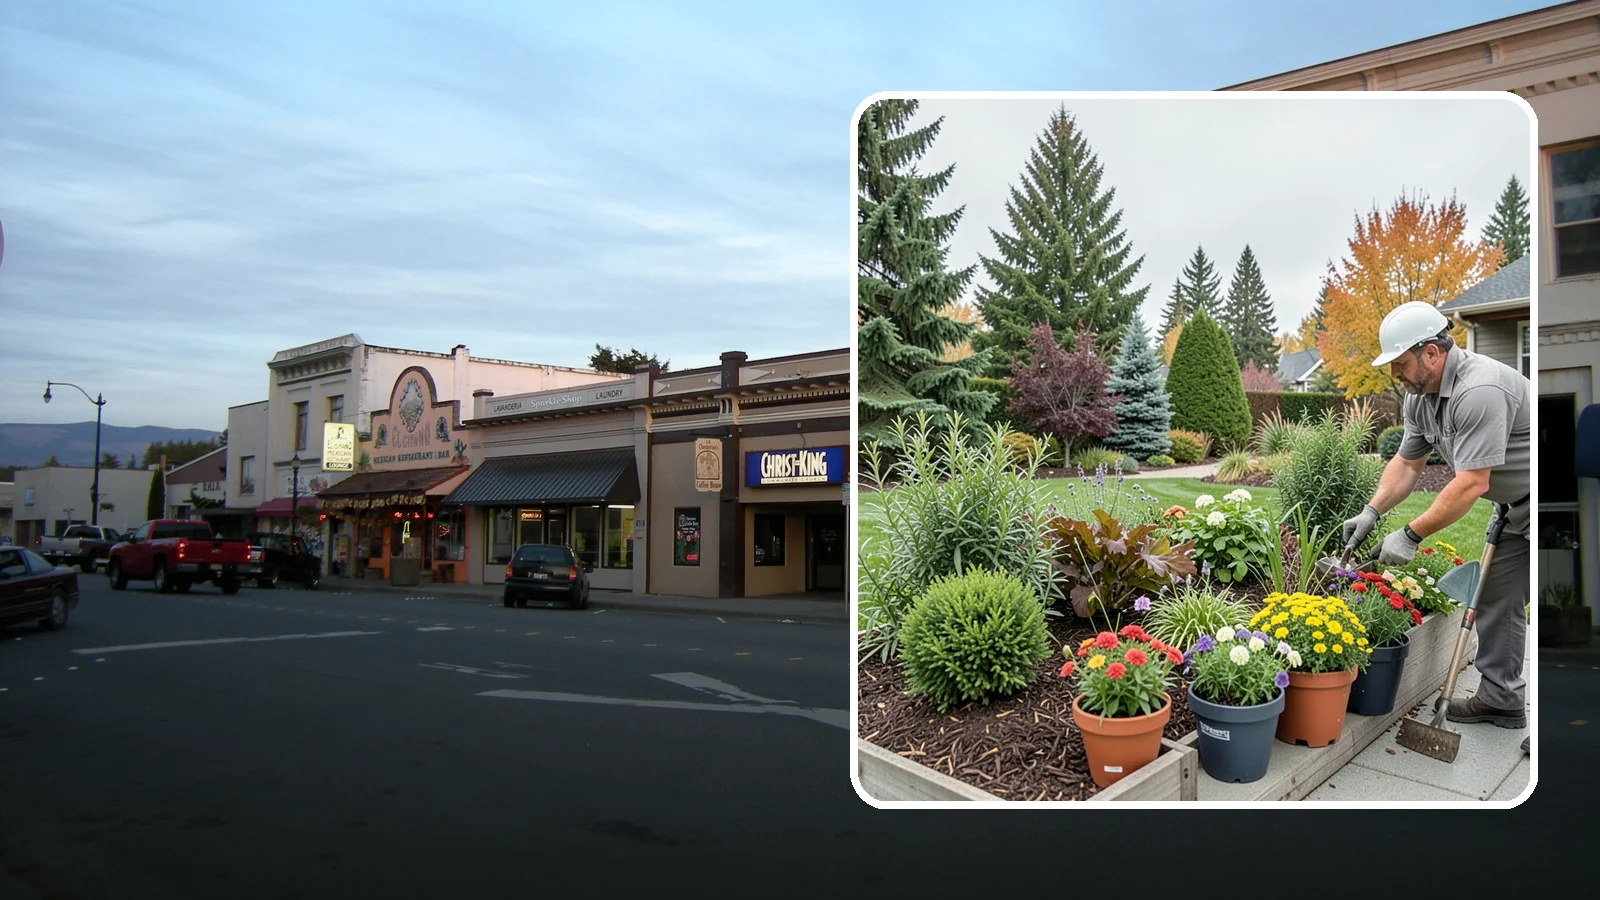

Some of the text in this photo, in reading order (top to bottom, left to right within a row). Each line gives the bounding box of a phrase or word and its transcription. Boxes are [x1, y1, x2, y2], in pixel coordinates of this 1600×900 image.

[595, 389, 623, 399] LAUNDRY
[493, 402, 522, 412] LAVANDERIA
[530, 394, 582, 409] Sparkle Shop
[397, 451, 433, 462] RESTAURANT
[438, 450, 450, 459] BAR
[761, 450, 827, 478] CHRIST KING
